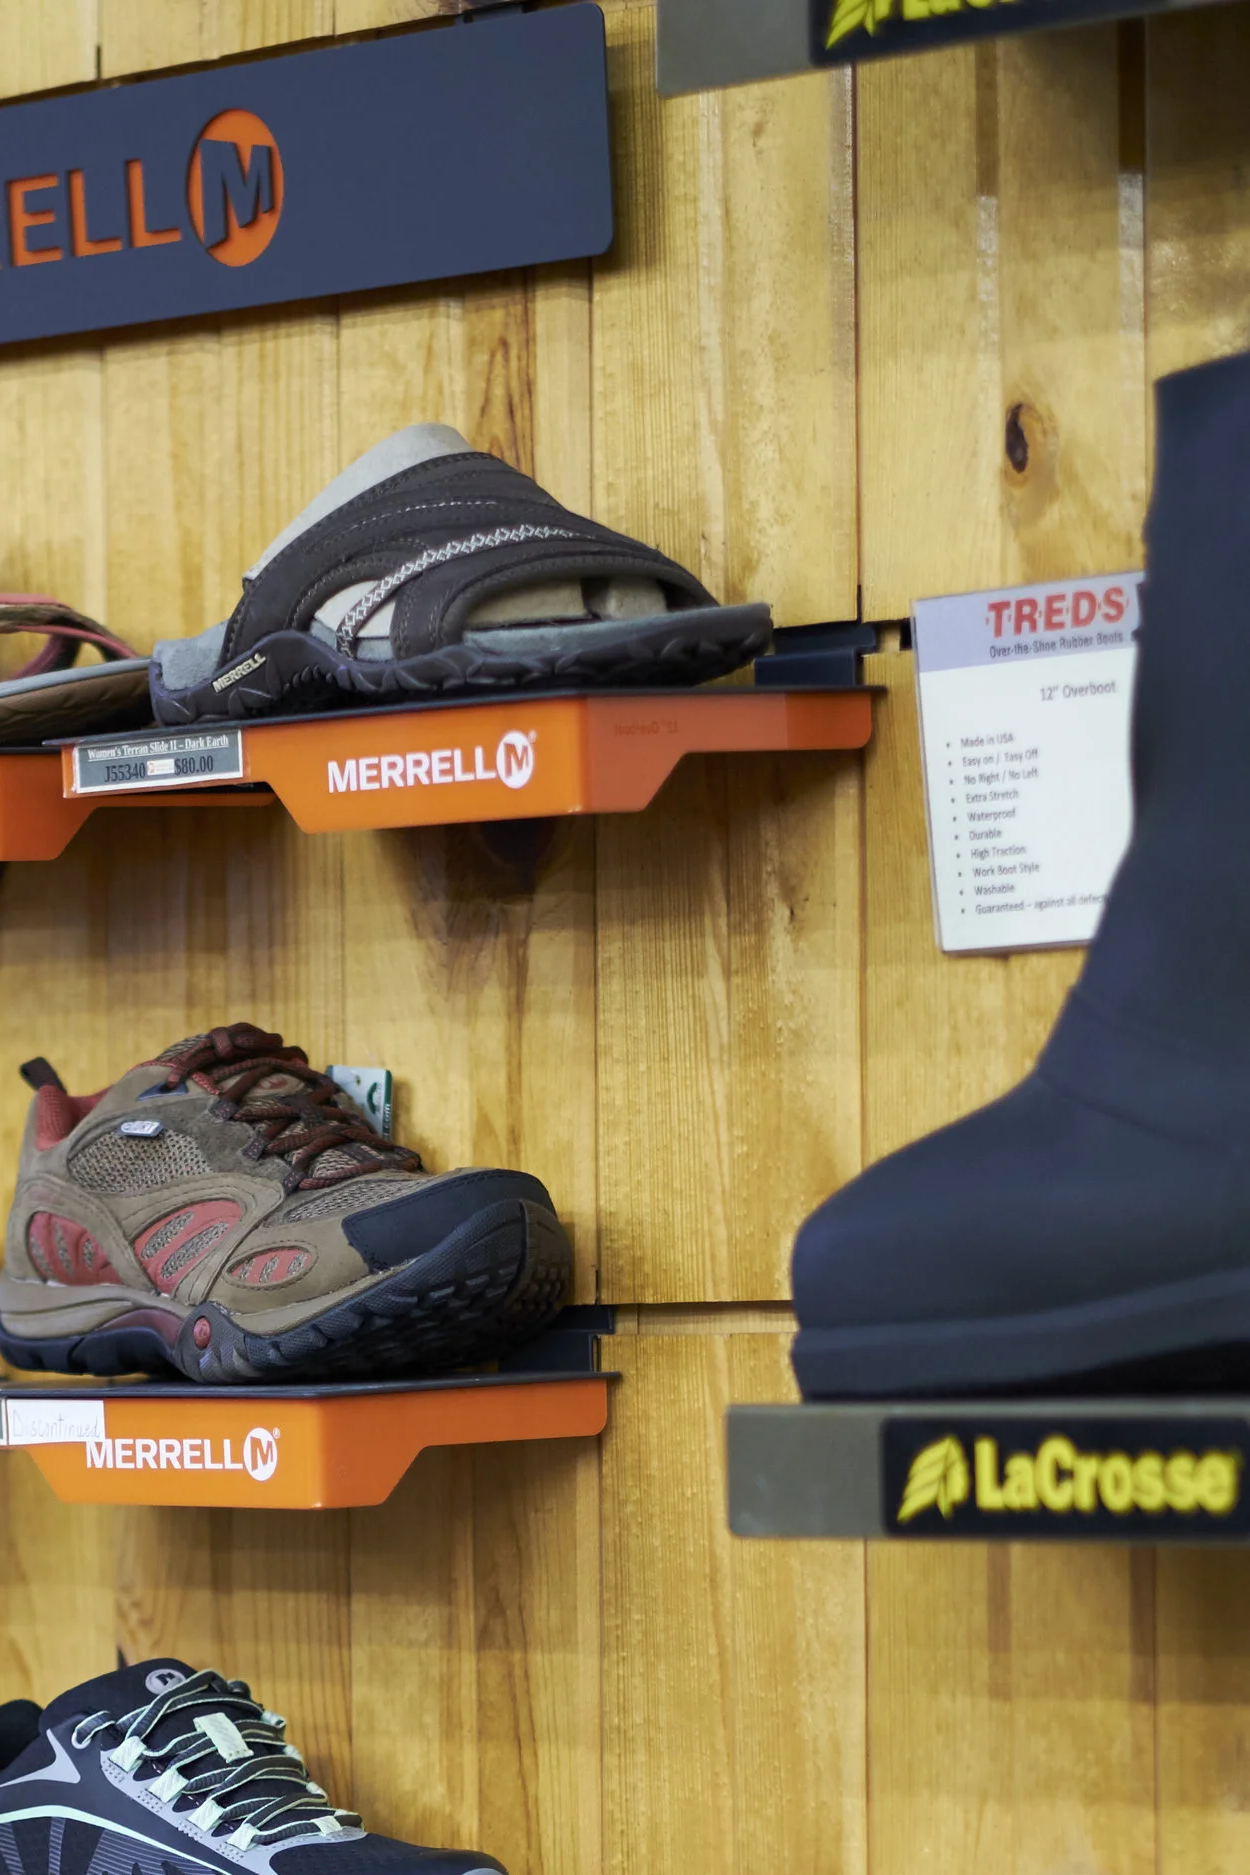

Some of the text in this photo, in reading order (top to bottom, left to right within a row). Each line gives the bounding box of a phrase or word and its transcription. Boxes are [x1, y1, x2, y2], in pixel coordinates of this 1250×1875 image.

[987, 585, 1126, 638] TREDS
[989, 631, 1123, 659] Over-the-Shoe Rubber Boots
[212, 652, 266, 693] MERRELL
[1040, 680, 1116, 702] 12" Overboot
[87, 747, 122, 761] Women's
[123, 744, 148, 757] Terran
[150, 740, 169, 754] Slide
[185, 736, 204, 750] Dark
[206, 734, 228, 748] Earth
[960, 733, 1014, 749] Made in USA
[104, 755, 214, 782] J55340 $80.00
[963, 756, 981, 768] Easy
[983, 756, 993, 765] on
[1005, 752, 1023, 764] Easy
[1025, 748, 1039, 760] Off
[327, 747, 496, 794] MERRELL
[964, 774, 976, 785] No
[978, 771, 1000, 786] Right
[1009, 770, 1021, 781] No
[1022, 767, 1039, 780] Left
[966, 788, 1019, 804] Extra Stretch
[967, 808, 1017, 823] Waterproof
[969, 829, 1002, 841] Durable
[971, 845, 1026, 861] High Traction
[973, 861, 1040, 878] Work Boot Style
[974, 884, 1015, 896] Washable
[975, 900, 1025, 915] Guaranteed
[1034, 898, 1064, 912] against
[1066, 896, 1076, 906] all
[12, 1410, 100, 1438] Discontinued
[86, 1438, 244, 1469] MERRELL
[974, 1435, 1237, 1513] LaCrosse
